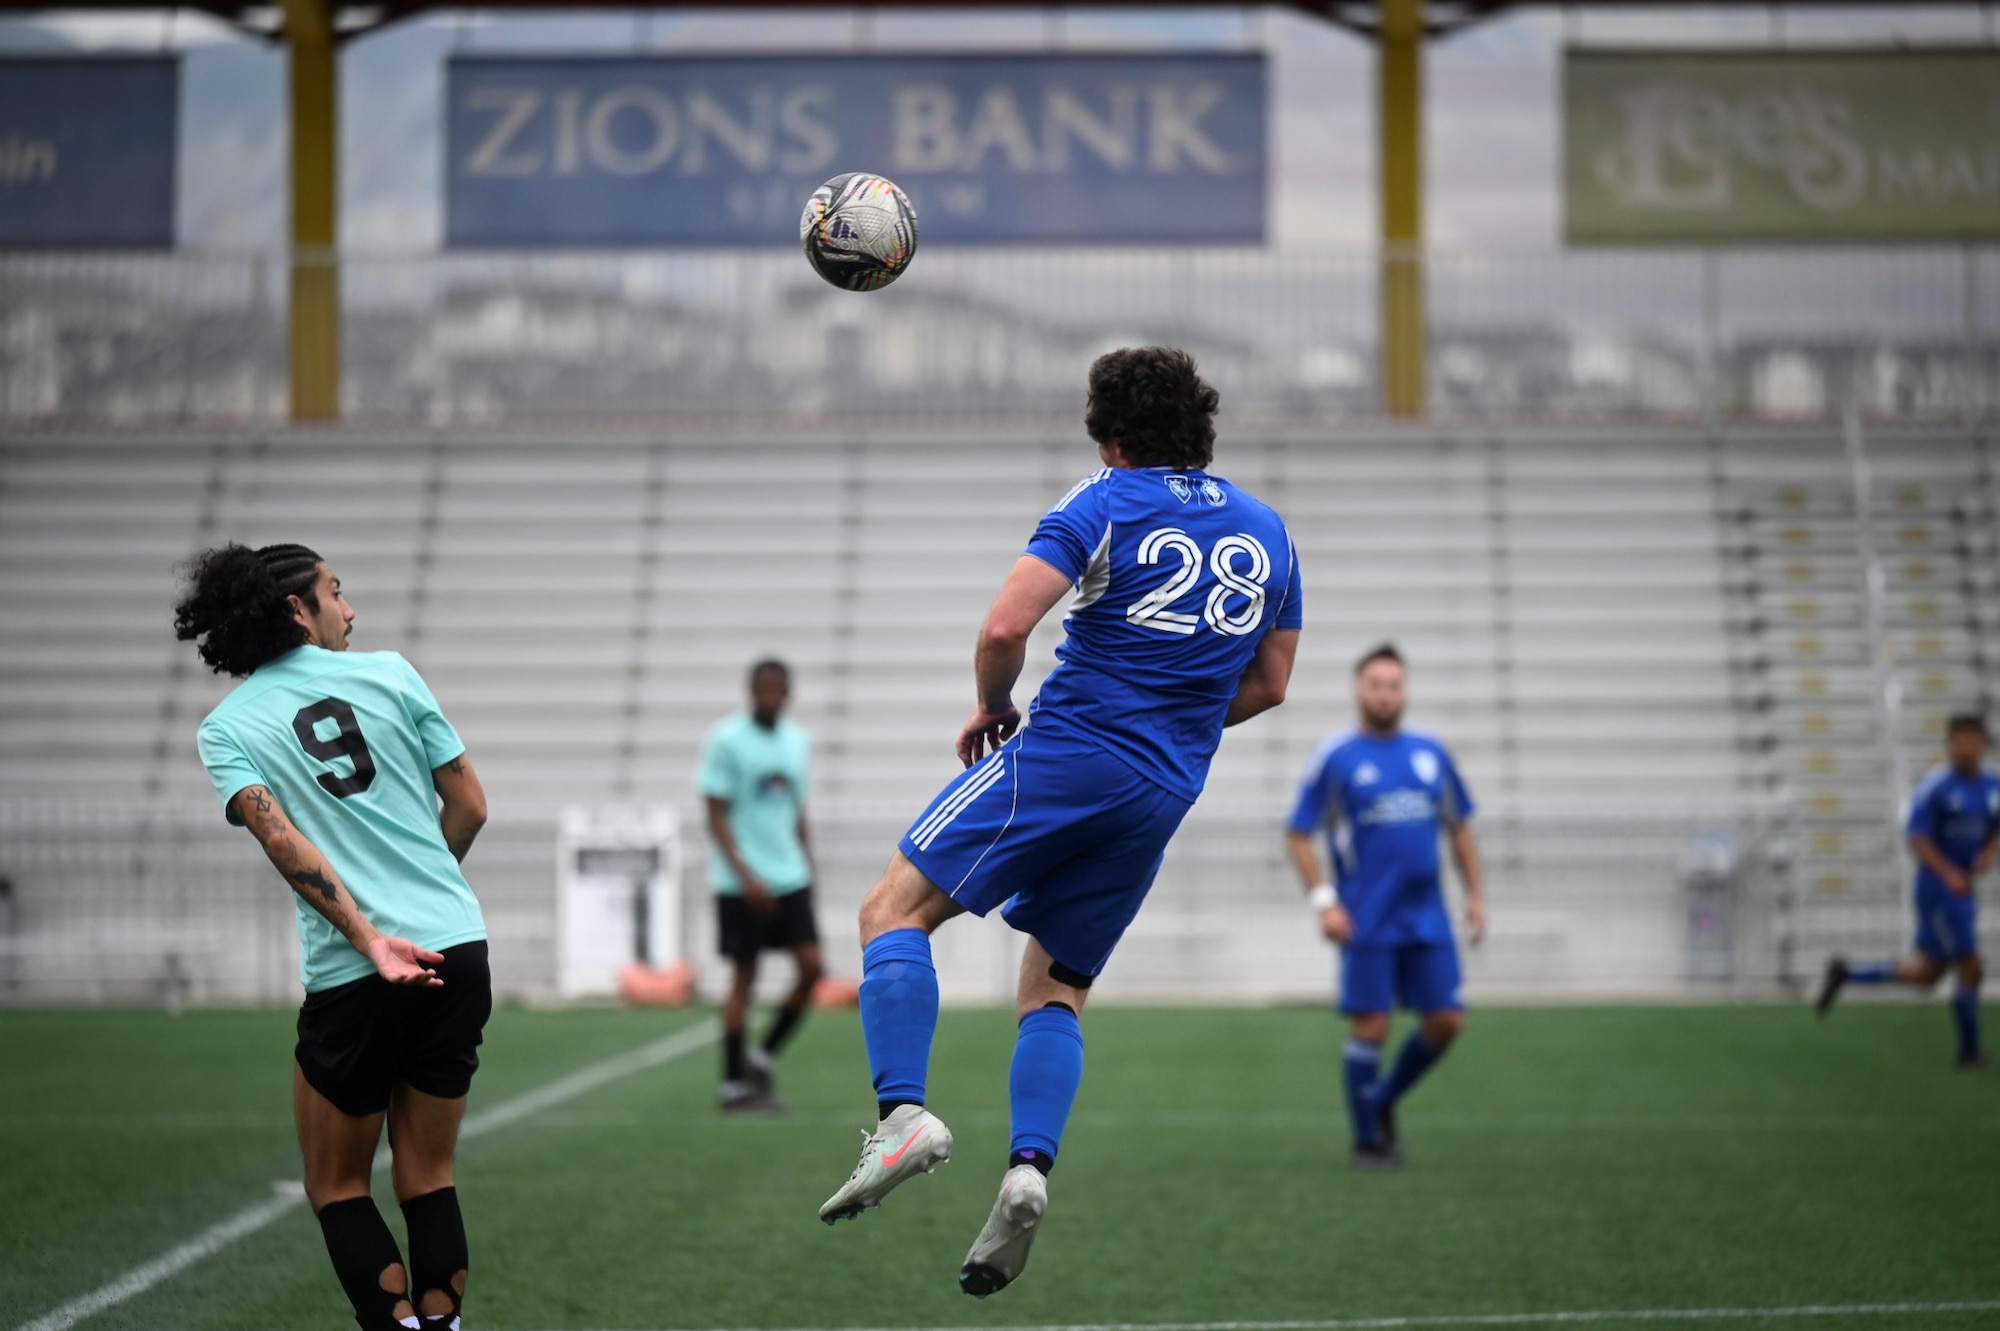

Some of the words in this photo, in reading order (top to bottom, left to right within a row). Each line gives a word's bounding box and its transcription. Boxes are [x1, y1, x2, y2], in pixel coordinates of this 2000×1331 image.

[463, 85, 840, 179] ZIONS
[890, 82, 1236, 177] BANK
[1126, 527, 1271, 636] 28
[292, 696, 376, 799] 9
